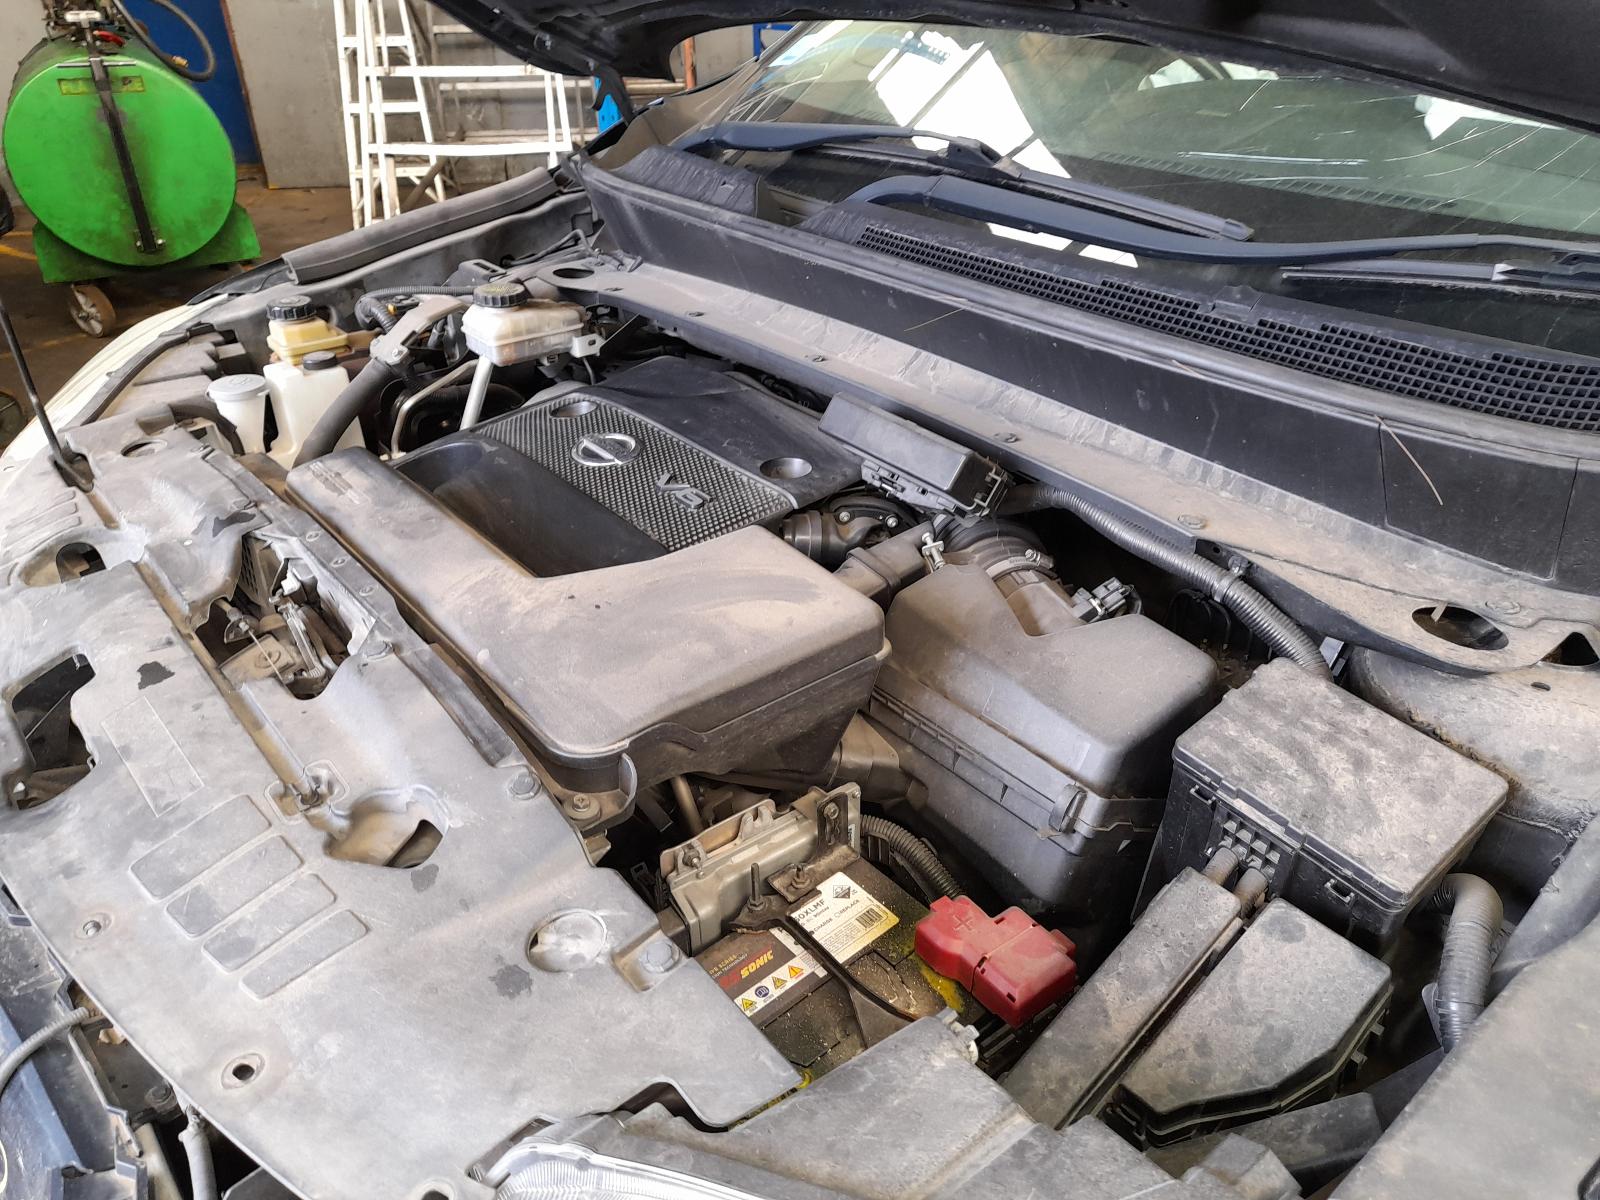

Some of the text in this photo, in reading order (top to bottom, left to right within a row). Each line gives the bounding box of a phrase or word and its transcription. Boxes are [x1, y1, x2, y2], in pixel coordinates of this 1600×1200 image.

[656, 470, 713, 511] V6
[813, 918, 833, 932] CHARGE
[740, 949, 774, 979] SONIC
